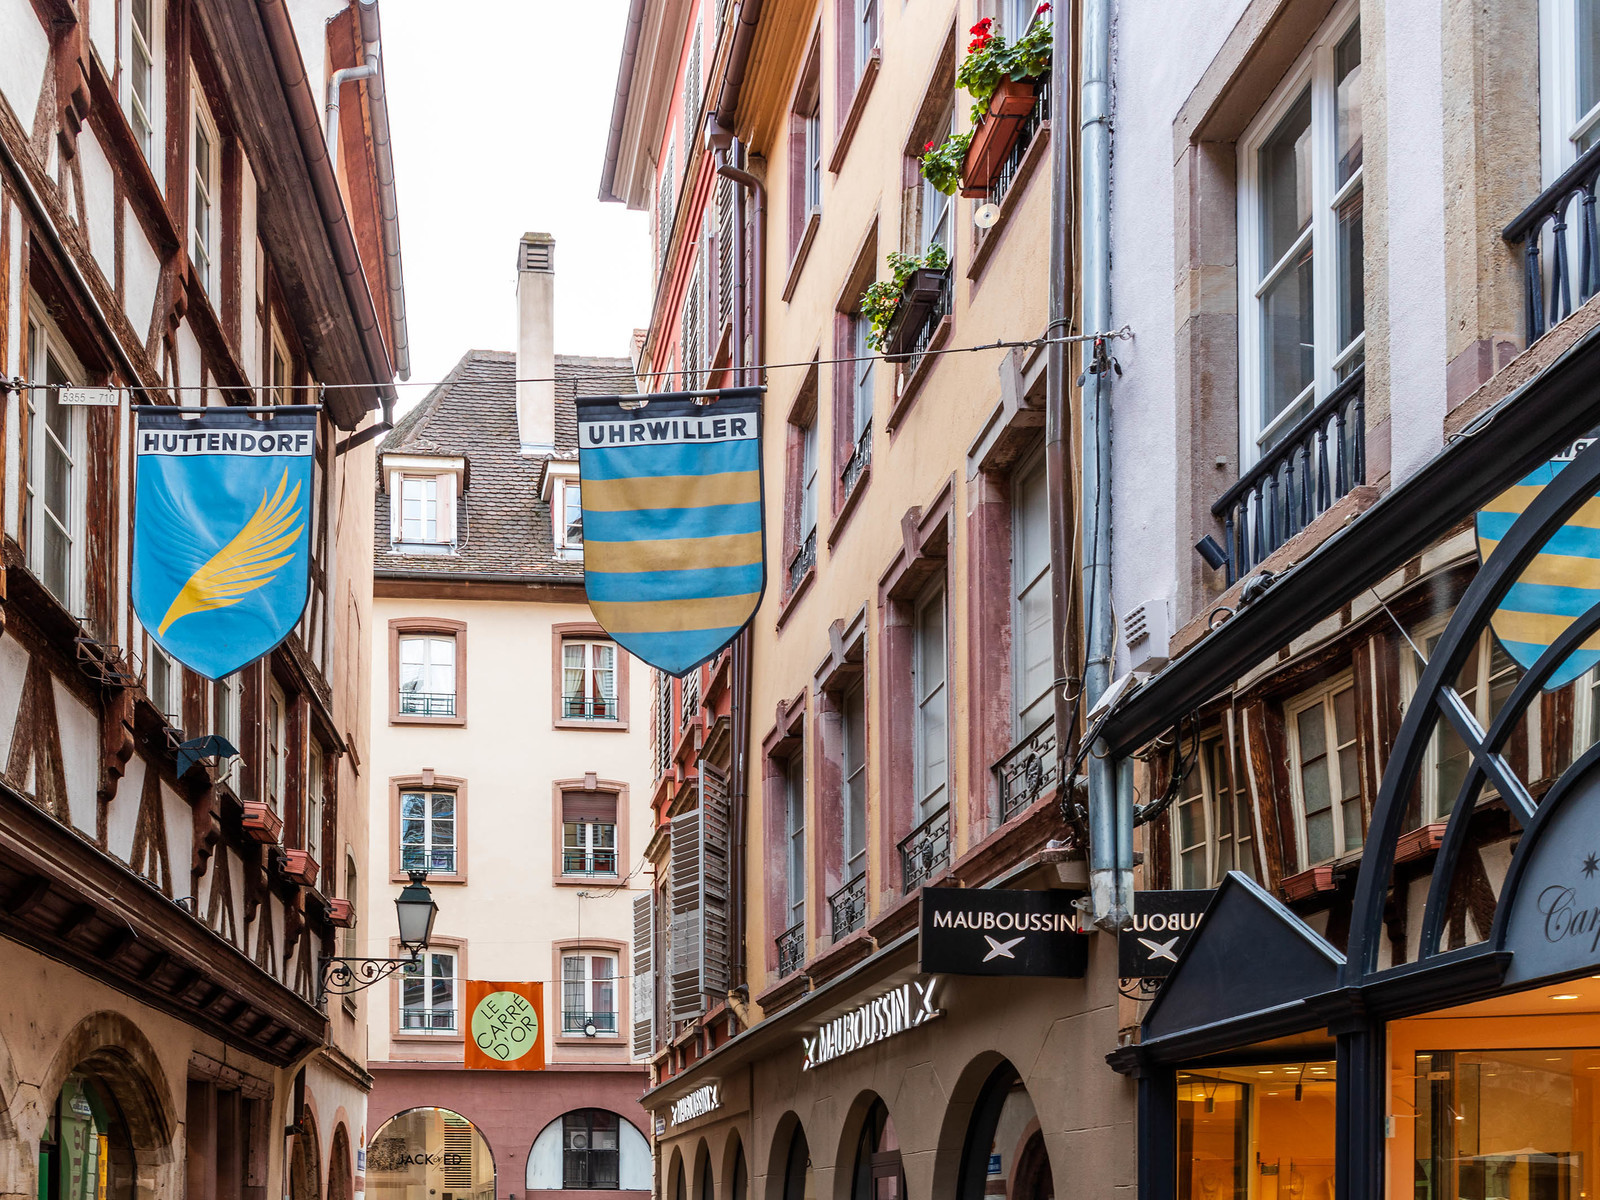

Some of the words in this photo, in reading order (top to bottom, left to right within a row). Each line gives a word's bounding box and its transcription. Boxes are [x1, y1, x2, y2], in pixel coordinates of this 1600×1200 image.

[62, 392, 86, 403] 5355
[99, 393, 115, 404] 710
[143, 432, 309, 452] HUTTENDORF
[588, 417, 747, 445] UHRWILLER
[933, 909, 1077, 932] MAUBOUSSIN
[480, 999, 500, 1020] LE
[476, 993, 530, 1050] CARRÉ
[816, 983, 910, 1064] MAUBOUSSIN
[493, 1015, 537, 1061] D'OR
[396, 1153, 434, 1165] JACK
[443, 1153, 462, 1166] ED
